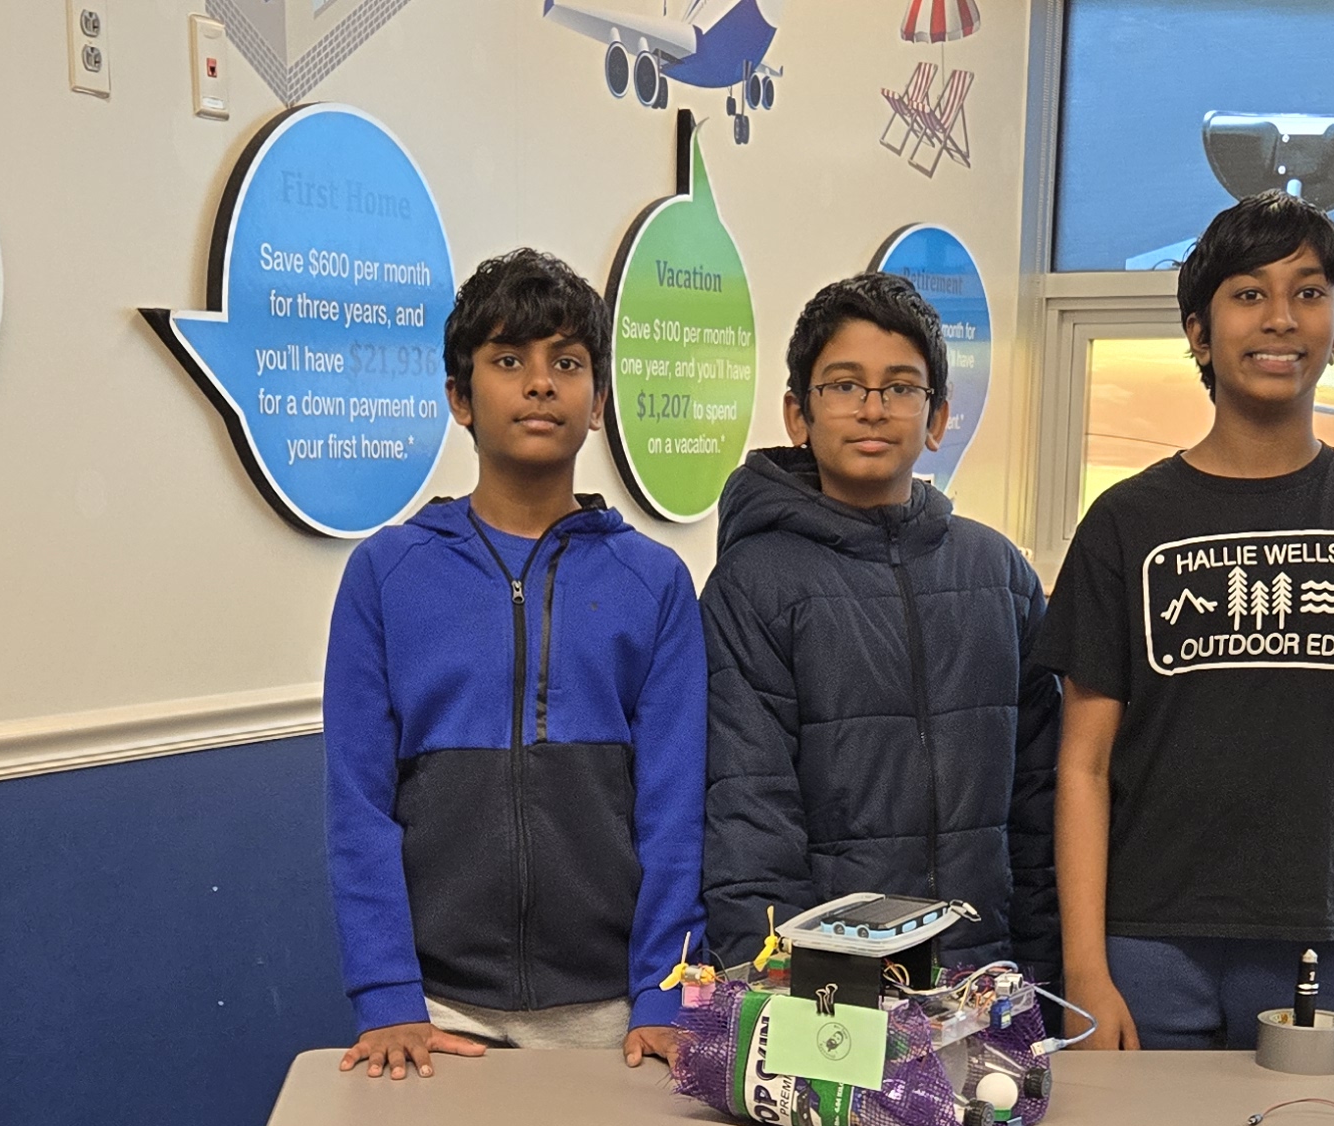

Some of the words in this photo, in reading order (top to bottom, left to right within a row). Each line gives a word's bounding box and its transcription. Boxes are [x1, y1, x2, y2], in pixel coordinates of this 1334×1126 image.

[281, 171, 339, 206] First
[346, 179, 410, 221] Home
[260, 243, 303, 274] Save
[309, 249, 349, 278] $600
[354, 259, 379, 286] per
[384, 262, 431, 286] month
[655, 260, 722, 292] Vacation
[270, 291, 293, 316] for
[297, 293, 339, 320] three
[344, 300, 391, 329] years,
[396, 304, 424, 327] and
[622, 316, 651, 339] Save
[653, 319, 680, 343] $100
[684, 324, 700, 347] per
[703, 326, 735, 345] month
[737, 326, 751, 346] for
[966, 322, 975, 340] for
[305, 347, 344, 372] have
[621, 358, 642, 375] one
[645, 359, 671, 380] year,
[675, 357, 694, 378] and
[726, 359, 751, 381] have
[956, 354, 974, 369] have
[259, 390, 282, 414] for
[287, 395, 297, 415] a
[302, 392, 345, 416] down
[349, 397, 415, 422] payment
[419, 399, 437, 418] on
[637, 390, 691, 424] $1,207
[693, 401, 704, 420] to
[706, 401, 737, 425] spend
[287, 436, 324, 465] your
[328, 434, 357, 459] first
[648, 437, 661, 454] on
[665, 438, 672, 453] a
[1177, 546, 1257, 575] HALLIE
[1181, 633, 1299, 660] OUTDOOR
